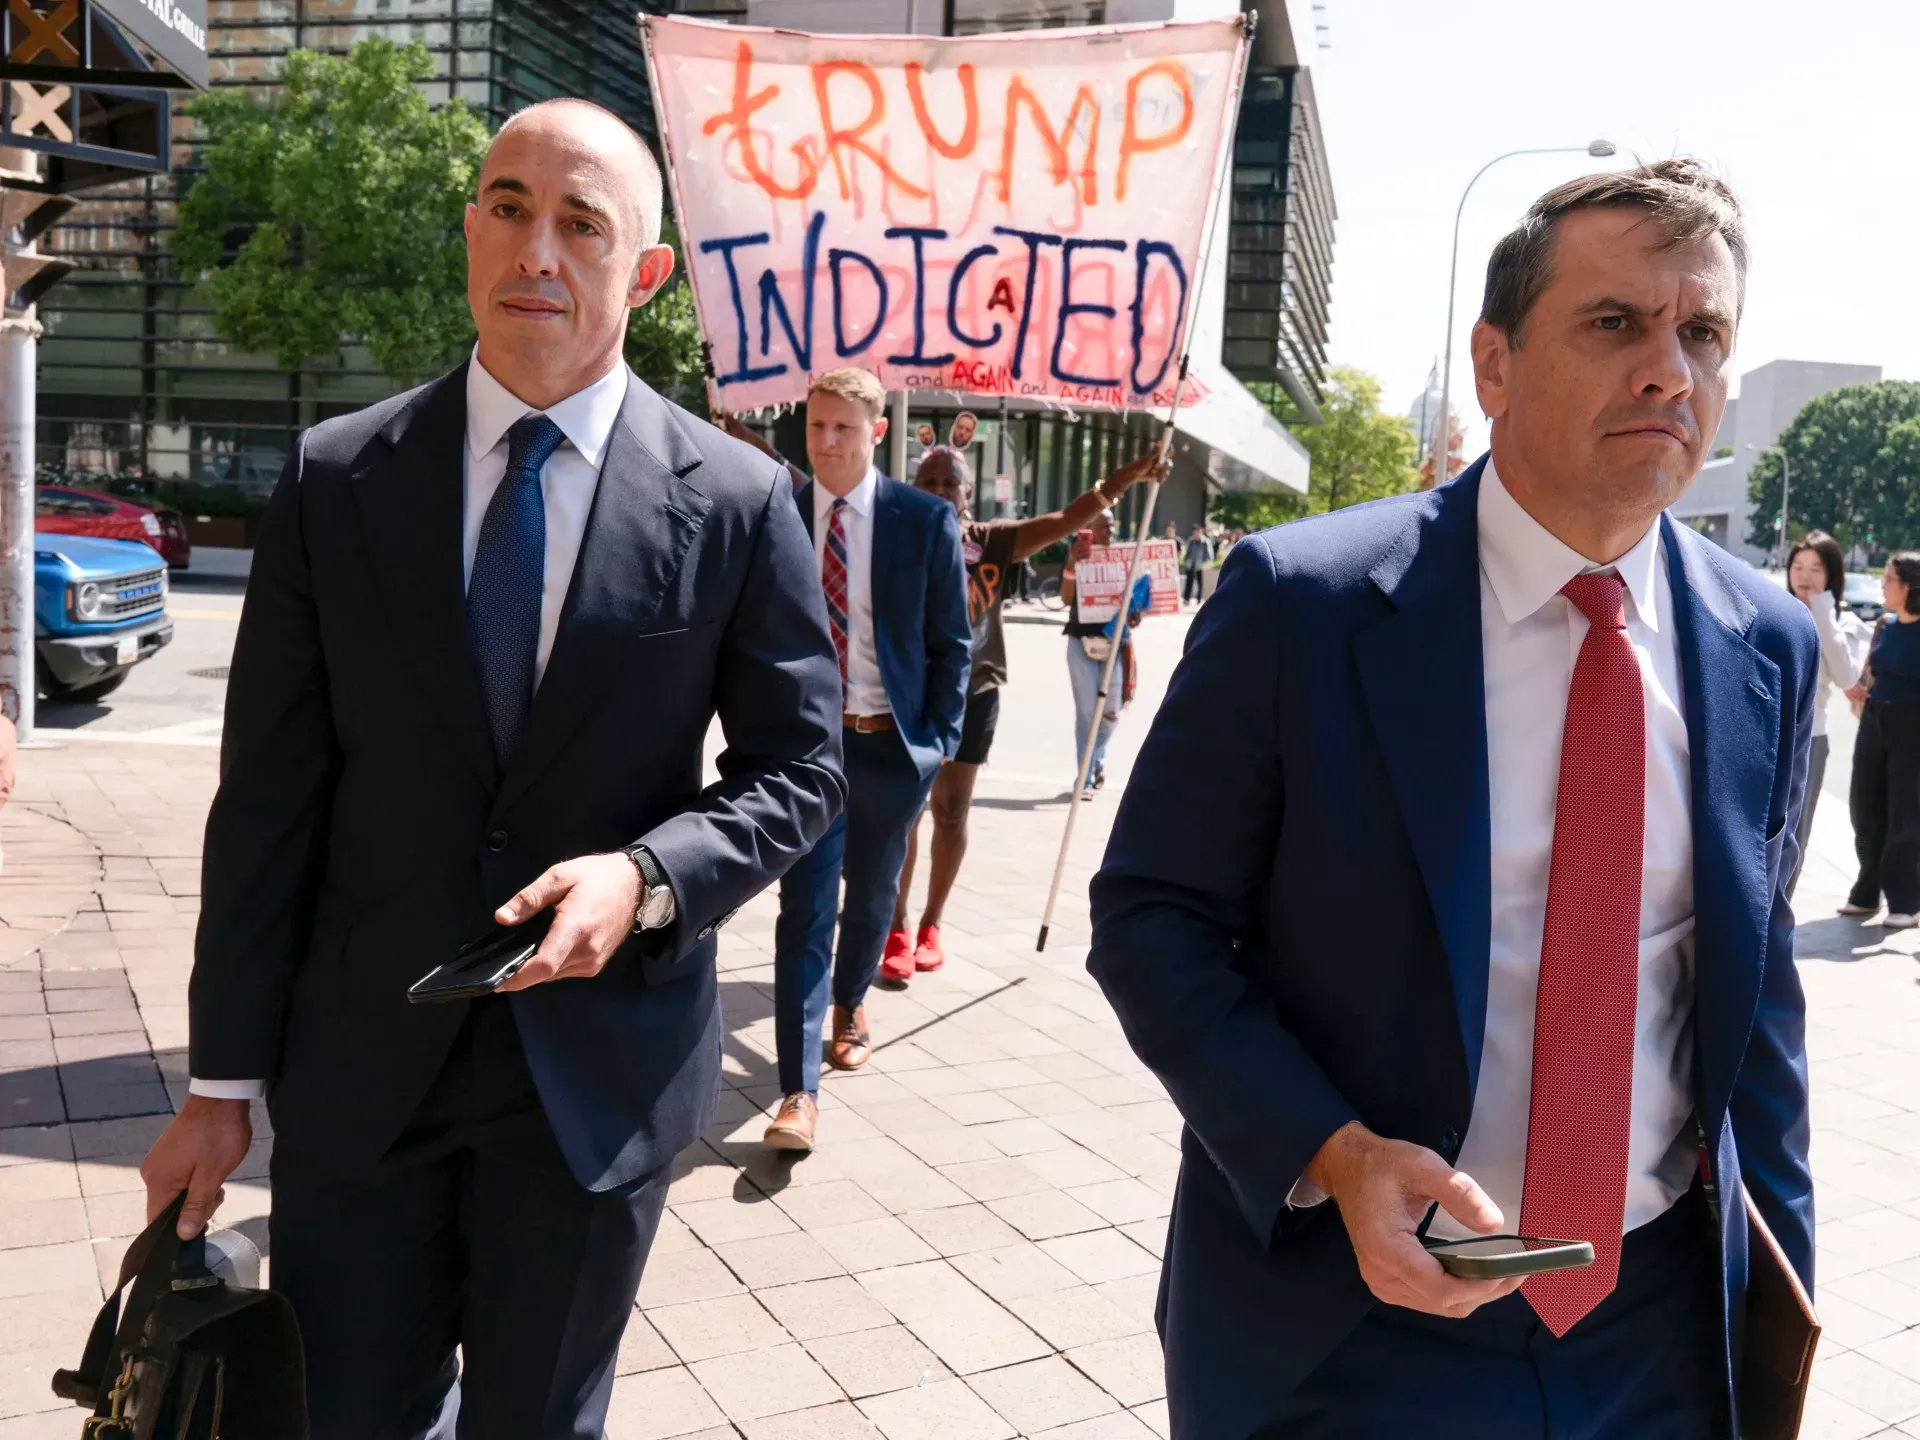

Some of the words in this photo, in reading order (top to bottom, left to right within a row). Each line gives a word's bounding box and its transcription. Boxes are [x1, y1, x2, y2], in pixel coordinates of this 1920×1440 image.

[173, 7, 206, 51] GRILLE
[701, 211, 1189, 395] INDICTED
[905, 367, 943, 387] and
[952, 360, 1014, 393] AGAIN
[1060, 385, 1123, 405] AGAIN
[1077, 561, 1126, 584] VOTING
[1153, 545, 1173, 559] FOR
